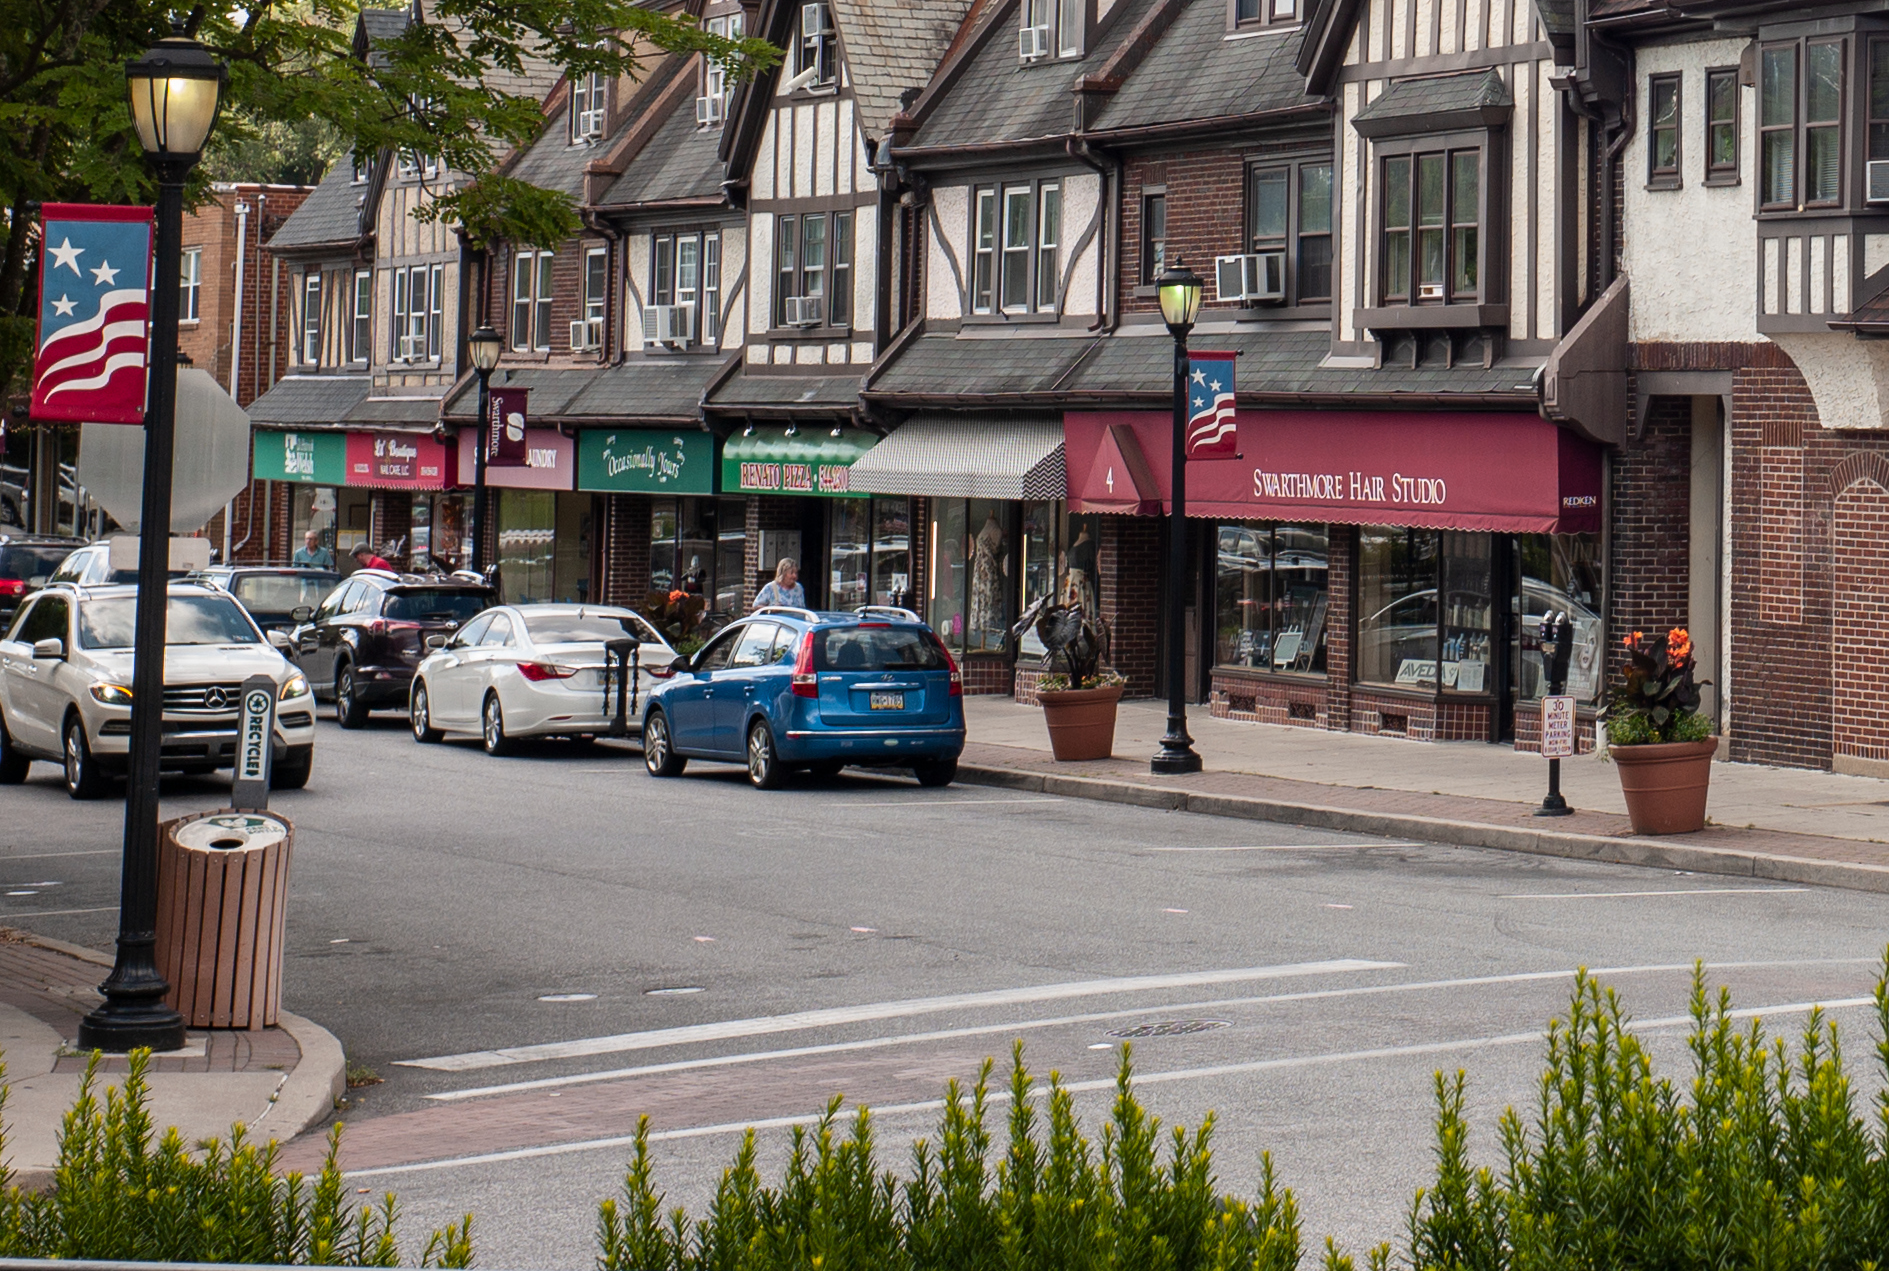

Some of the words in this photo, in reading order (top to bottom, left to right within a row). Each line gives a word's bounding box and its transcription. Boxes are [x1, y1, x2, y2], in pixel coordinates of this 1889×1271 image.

[491, 396, 504, 458] Swarthmore
[526, 448, 557, 468] AUNDRY
[608, 445, 656, 478] Occasionally
[657, 451, 680, 479] Yours
[741, 462, 781, 490] RENATO
[783, 463, 813, 491] PIZZA
[1106, 466, 1114, 494] 4
[1563, 495, 1597, 506] REDKEN
[1547, 711, 1570, 720] MINUTE
[1552, 700, 1565, 712] 30
[1548, 720, 1568, 730] METER
[246, 716, 263, 768] RECYCLE
